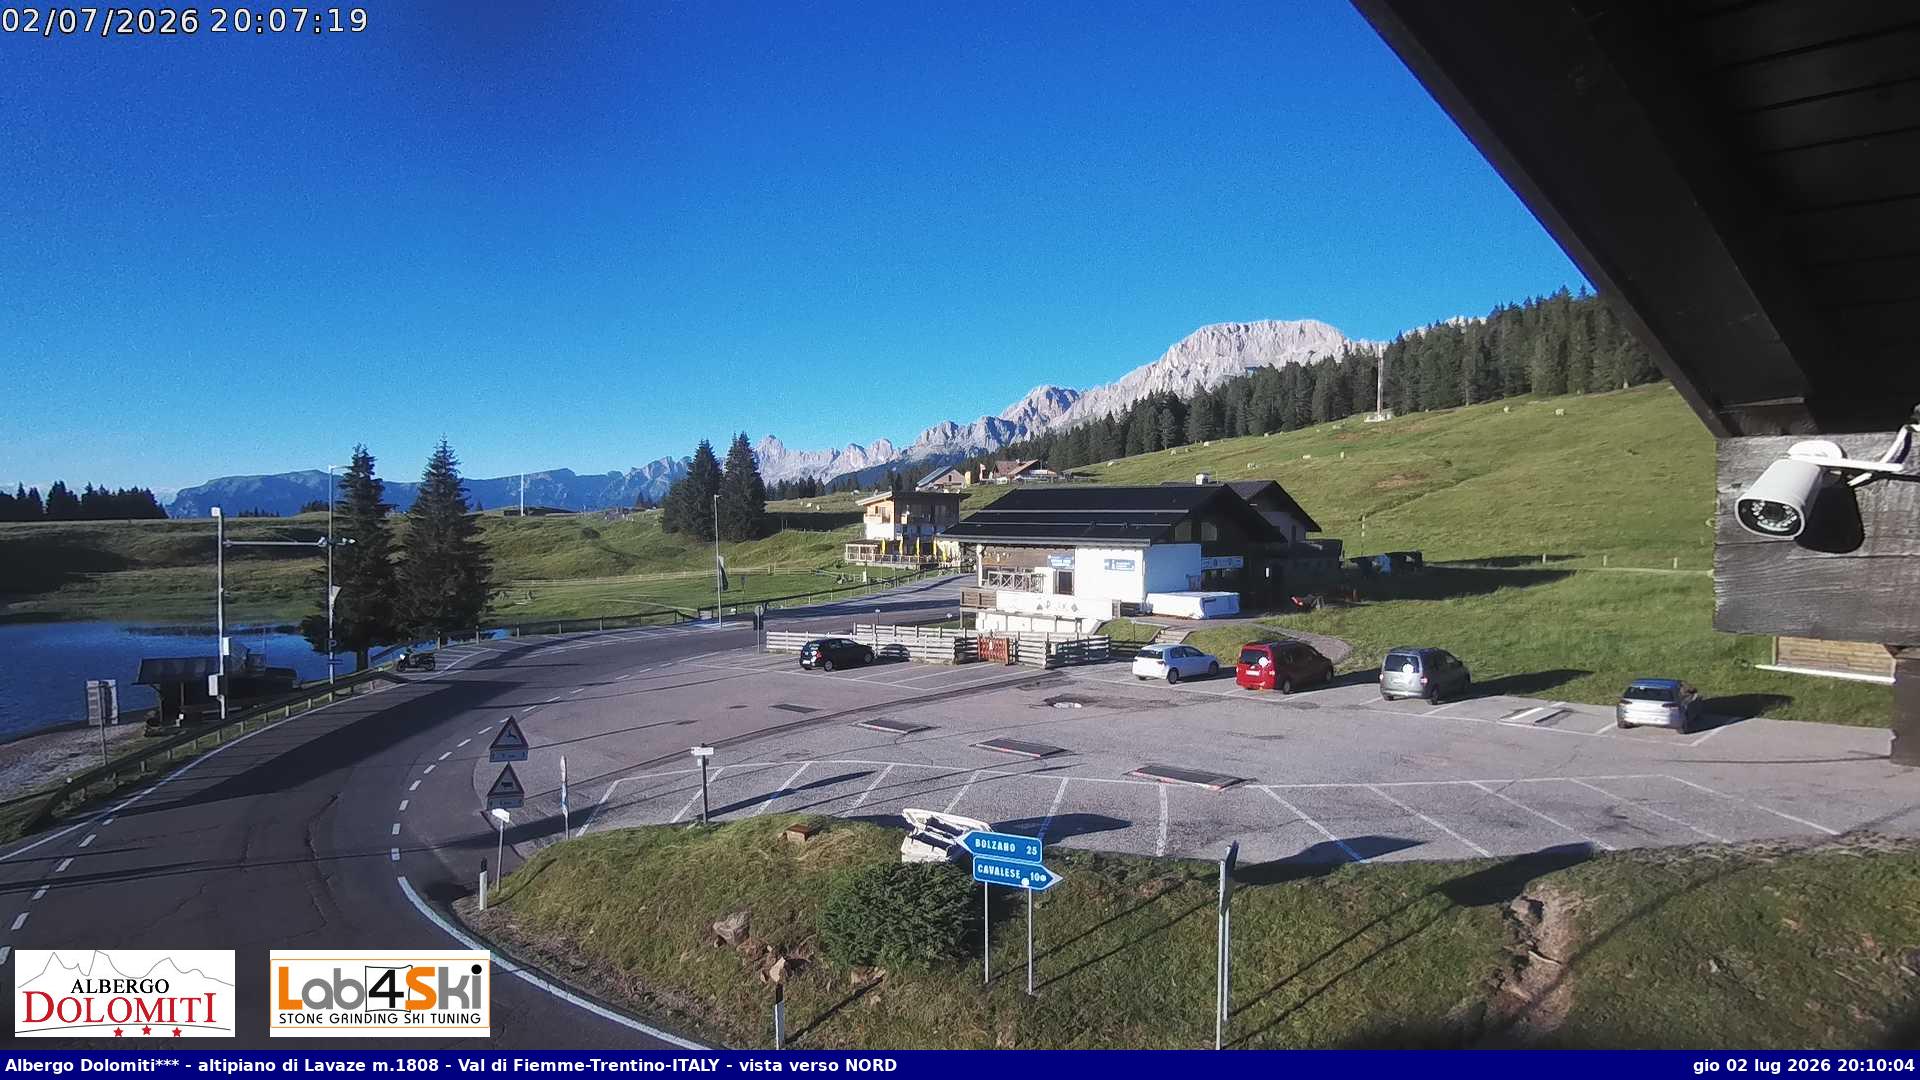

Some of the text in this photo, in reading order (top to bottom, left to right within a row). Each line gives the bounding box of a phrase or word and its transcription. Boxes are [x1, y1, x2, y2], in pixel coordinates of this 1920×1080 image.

[975, 838, 1038, 856] BOLZANO 25
[977, 864, 1021, 879] CAVALESE
